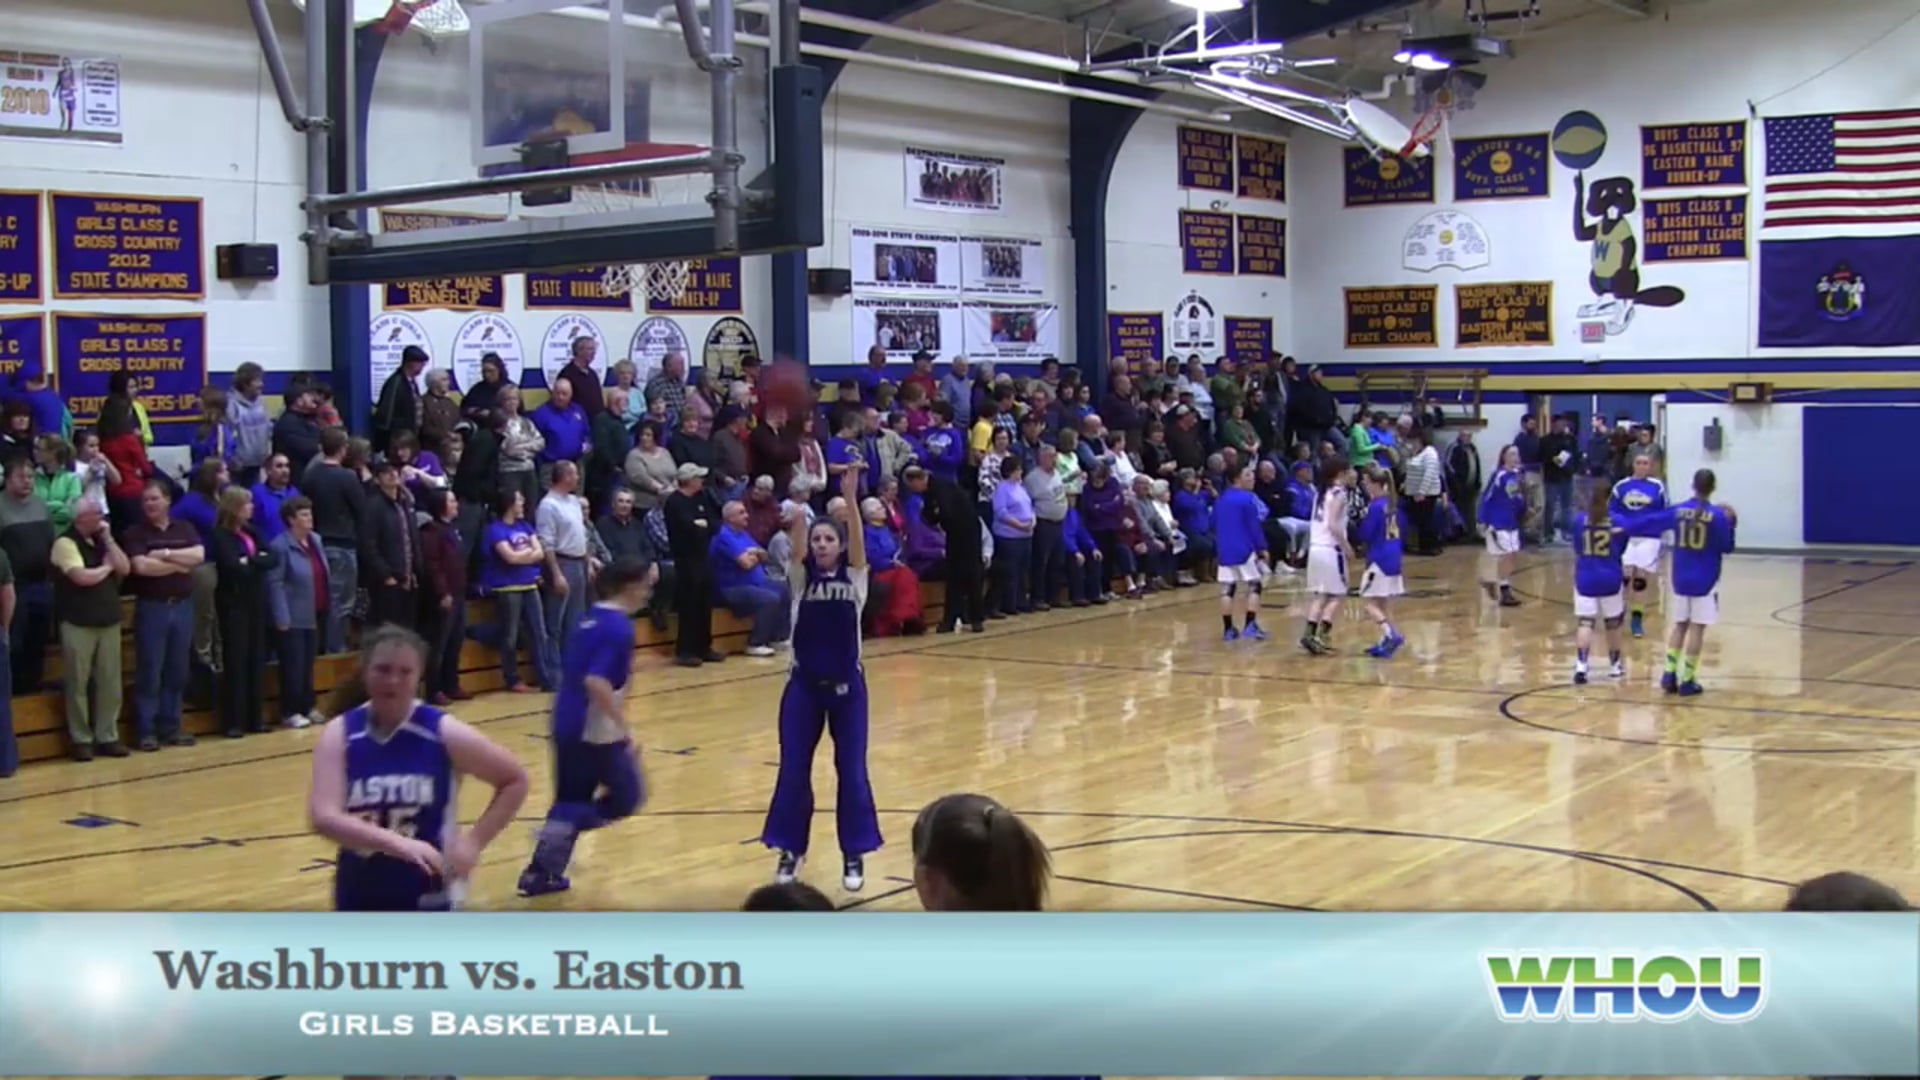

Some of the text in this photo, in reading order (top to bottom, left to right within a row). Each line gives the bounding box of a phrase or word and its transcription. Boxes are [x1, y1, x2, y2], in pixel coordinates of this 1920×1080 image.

[1654, 129, 1679, 141] BOYS
[1687, 127, 1719, 138] CLASS
[1662, 141, 1724, 155] BASKETBALL
[1730, 139, 1743, 151] 97
[1653, 154, 1734, 170] EASTERN MAINE
[1667, 170, 1720, 183] RUNNER-UP
[94, 201, 162, 214] WASHBURN
[1656, 202, 1681, 215] BOYS
[1688, 199, 1720, 212] CLASS
[7, 216, 17, 230] C
[76, 217, 178, 232] GIRLS CLASS C
[1663, 213, 1724, 228] BASKETBALL
[1731, 212, 1743, 225] 97
[1706, 227, 1744, 240] LEAGUE
[74, 235, 182, 249] CROSS COUNTRY
[1595, 241, 1610, 262] W
[1667, 243, 1720, 257] CHAMPIONS
[109, 253, 151, 267] 2012
[70, 272, 188, 289] STATE CHAMPIONS
[456, 276, 493, 293] MAINE
[706, 272, 732, 288] MAINE
[408, 287, 480, 304] RUNNER-UP
[532, 280, 561, 297] STATE
[1352, 302, 1429, 314] BOYS CLASS D
[1461, 297, 1488, 309] BOYS
[1493, 295, 1530, 306] CLASS
[98, 324, 165, 333] WASHBURN
[1461, 321, 1547, 335] EASTERN MAINE
[1350, 331, 1432, 342] STATE CHAMPS
[8, 340, 19, 353] C
[80, 338, 182, 352] GIRLS CLASS C
[79, 357, 184, 371] CROSS COUNTRY
[1679, 520, 1706, 549] 10
[1582, 530, 1611, 556] 12
